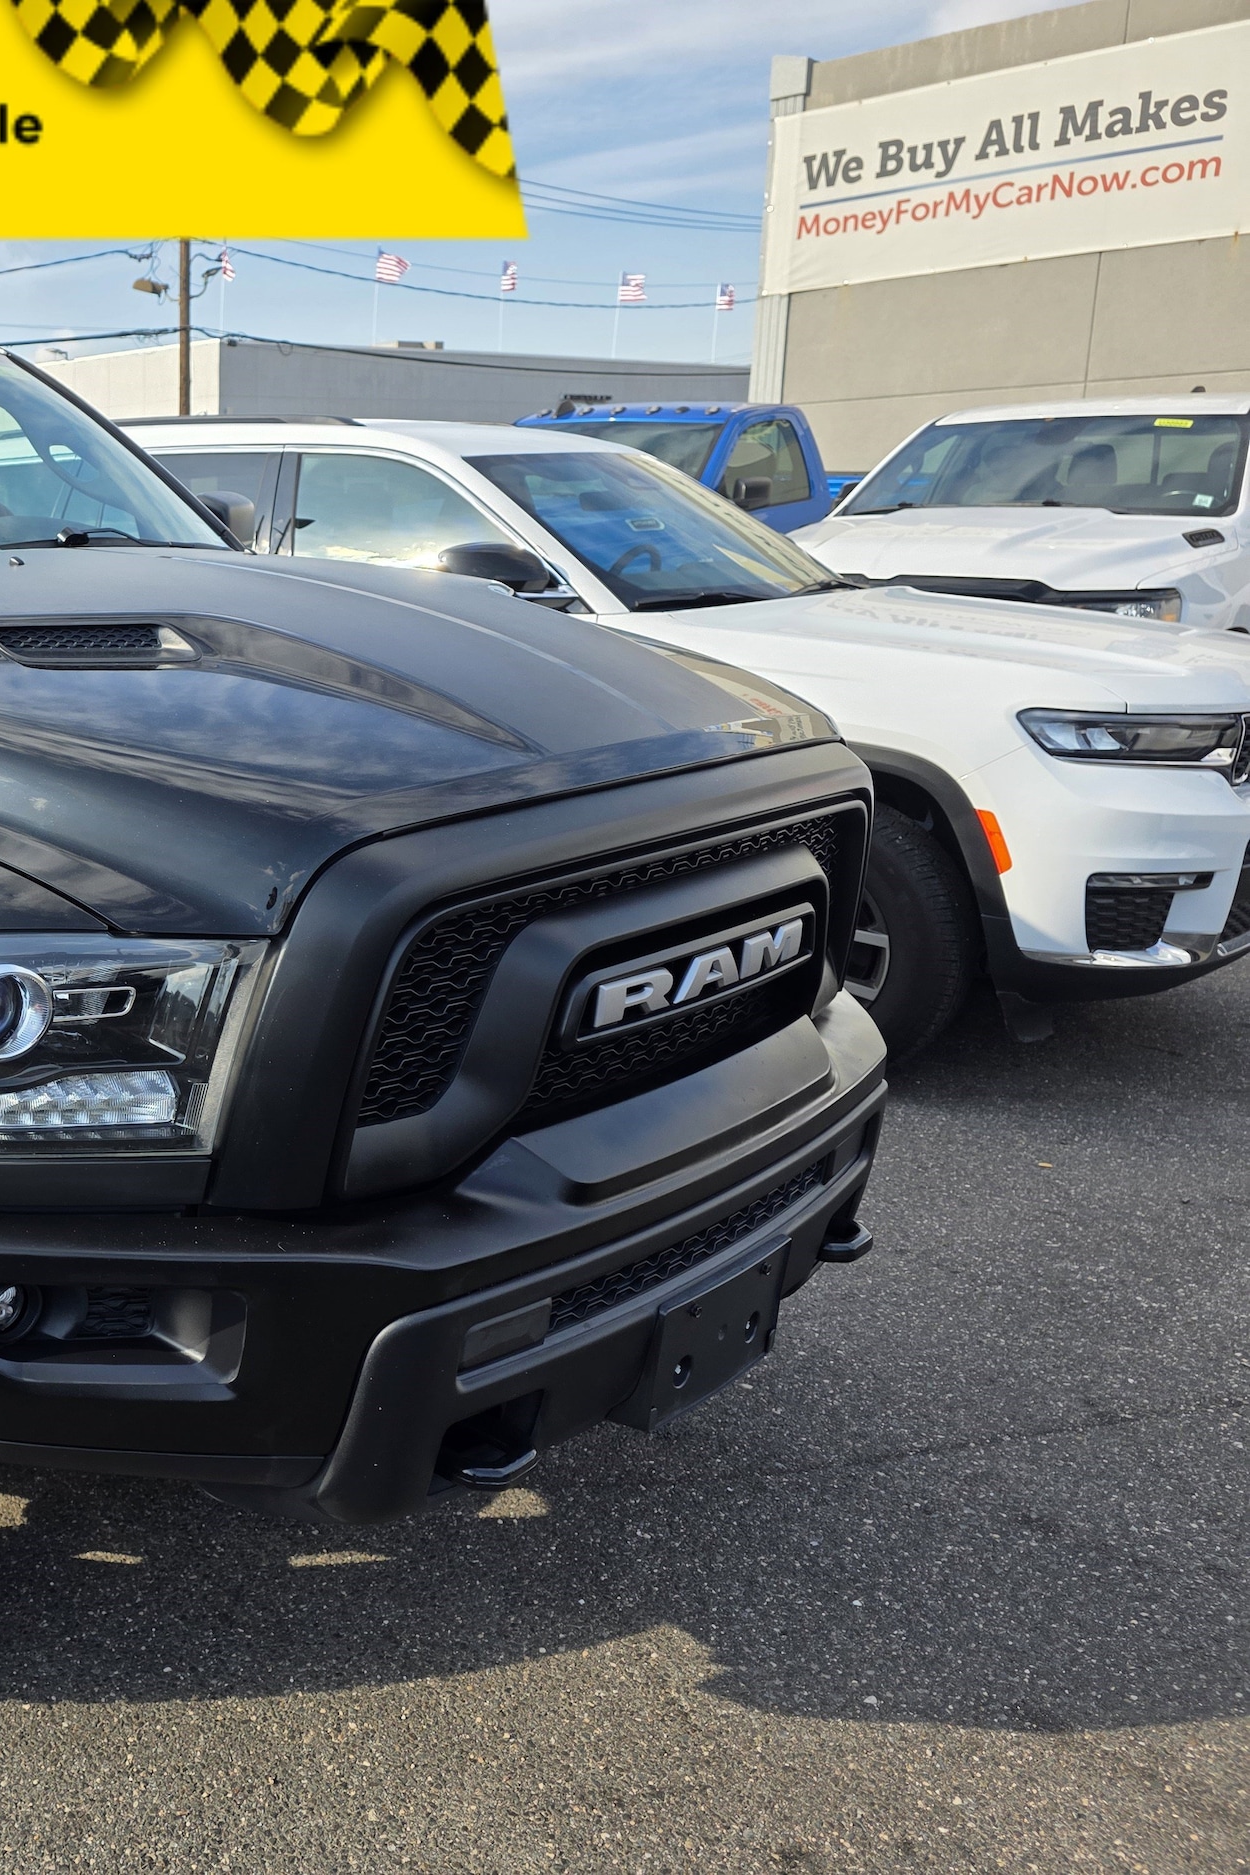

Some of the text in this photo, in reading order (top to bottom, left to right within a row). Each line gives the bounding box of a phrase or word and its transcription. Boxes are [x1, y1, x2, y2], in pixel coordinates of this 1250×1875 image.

[803, 88, 1228, 190] We Buy All Makes
[796, 156, 1223, 240] MoneyForMyCarNow.com
[594, 917, 803, 1029] RAM
